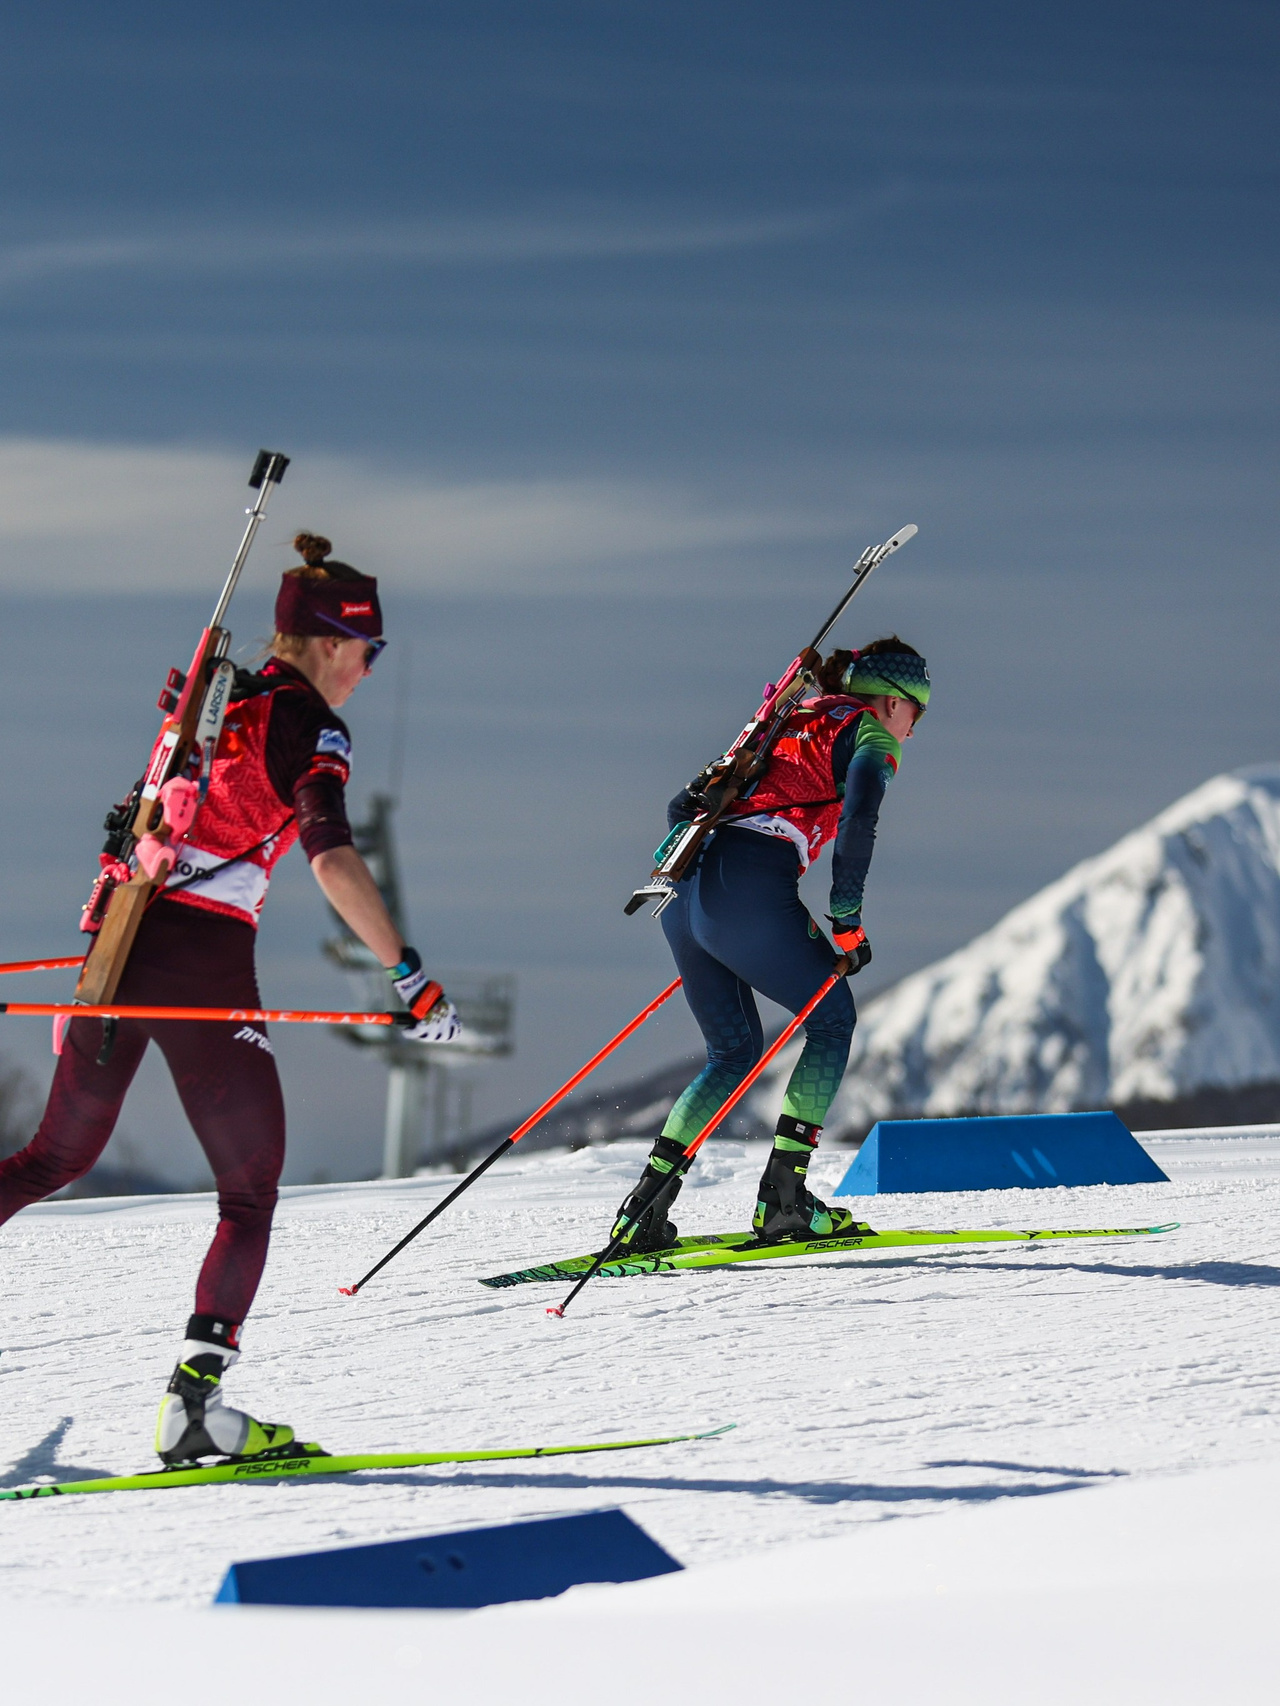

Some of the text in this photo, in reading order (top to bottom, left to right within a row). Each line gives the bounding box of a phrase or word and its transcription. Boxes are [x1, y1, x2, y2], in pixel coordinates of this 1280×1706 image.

[206, 676, 227, 725] LARSEN
[805, 1238, 863, 1251] FISCHER
[234, 1459, 311, 1476] FISCHER
